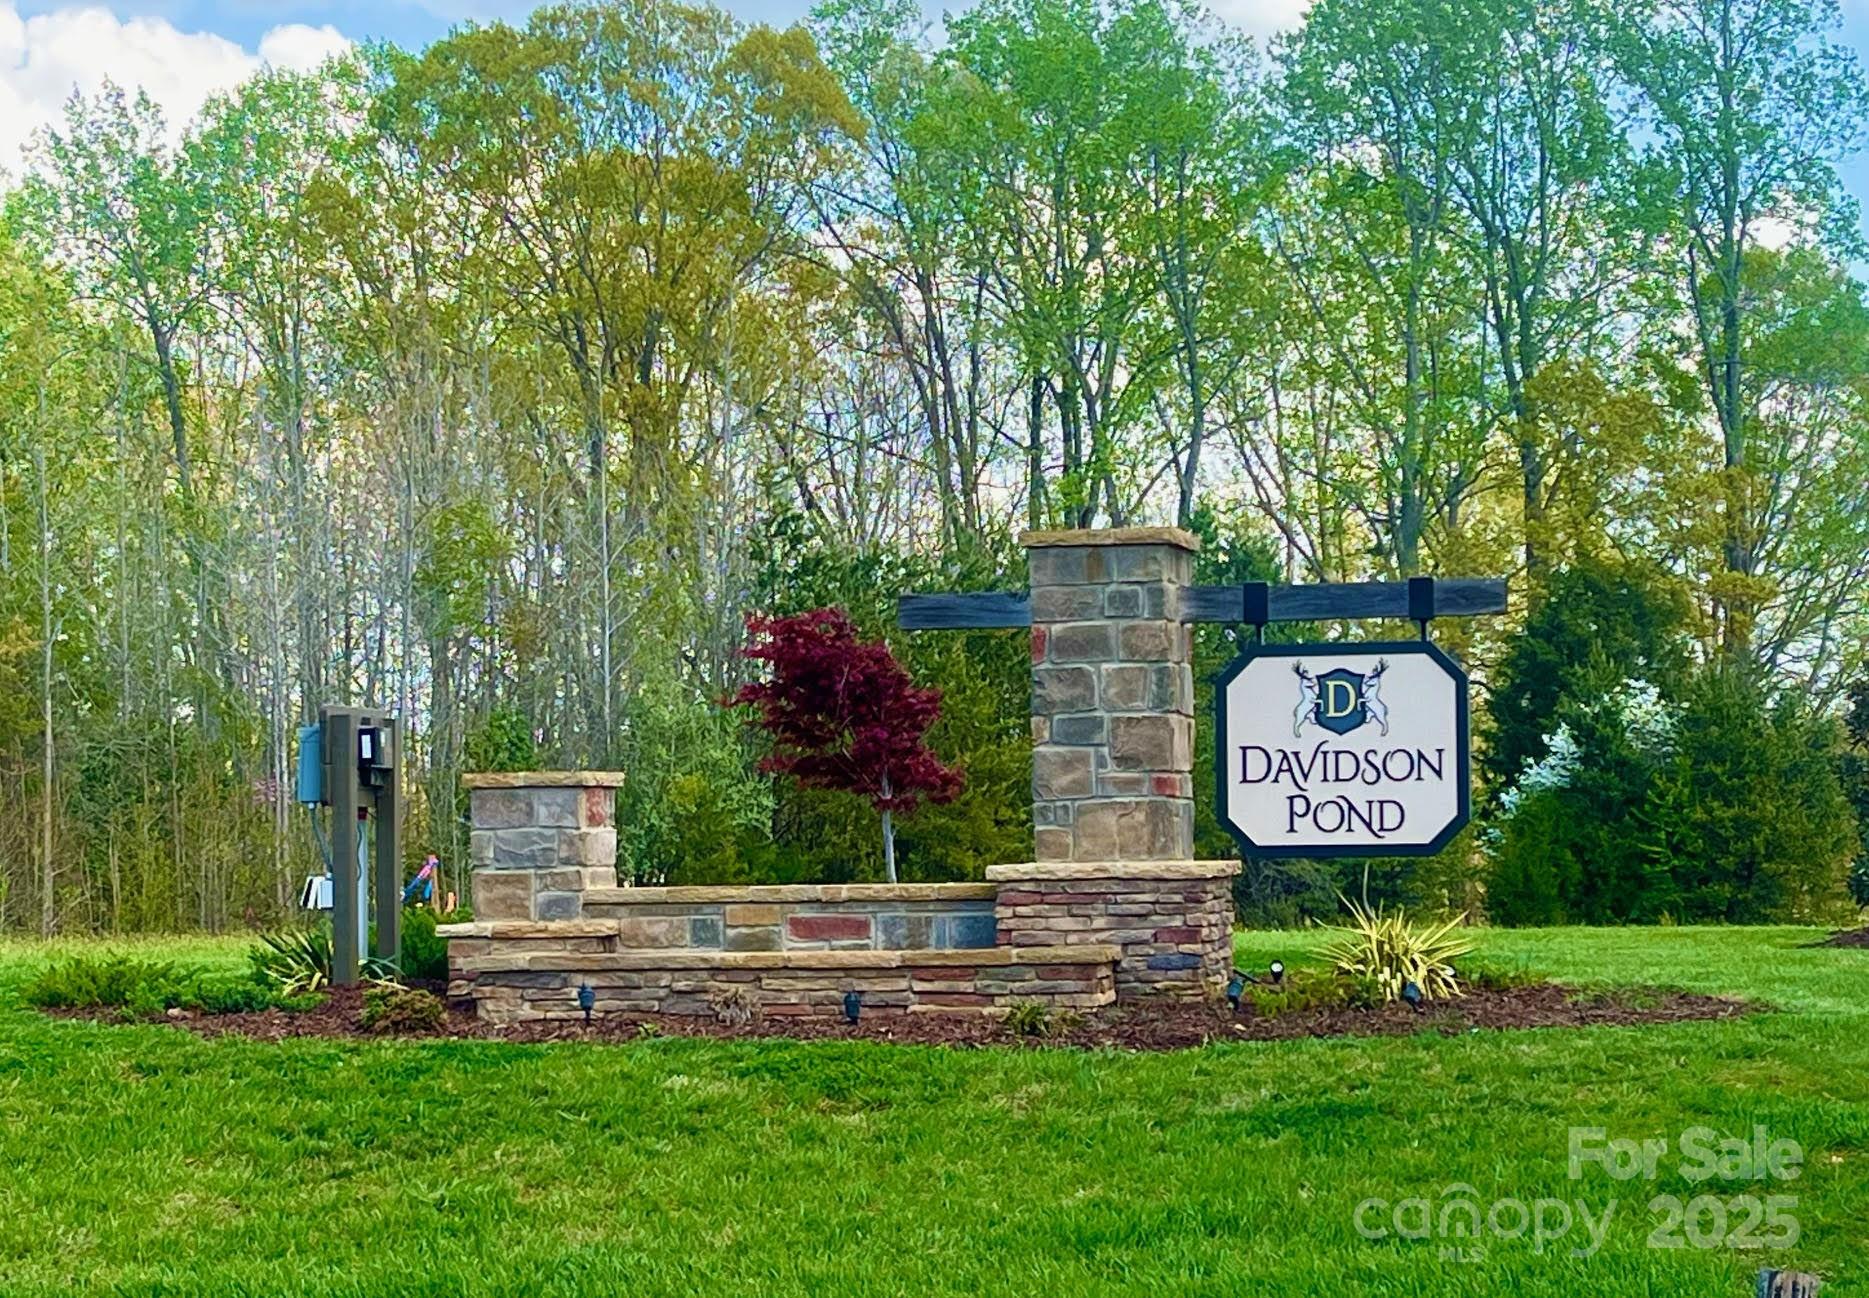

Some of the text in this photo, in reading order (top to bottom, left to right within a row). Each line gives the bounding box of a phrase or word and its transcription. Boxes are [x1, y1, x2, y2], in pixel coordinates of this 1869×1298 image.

[1326, 680, 1356, 717] D
[1238, 740, 1445, 791] DAVIDSON
[1286, 794, 1405, 838] POND
